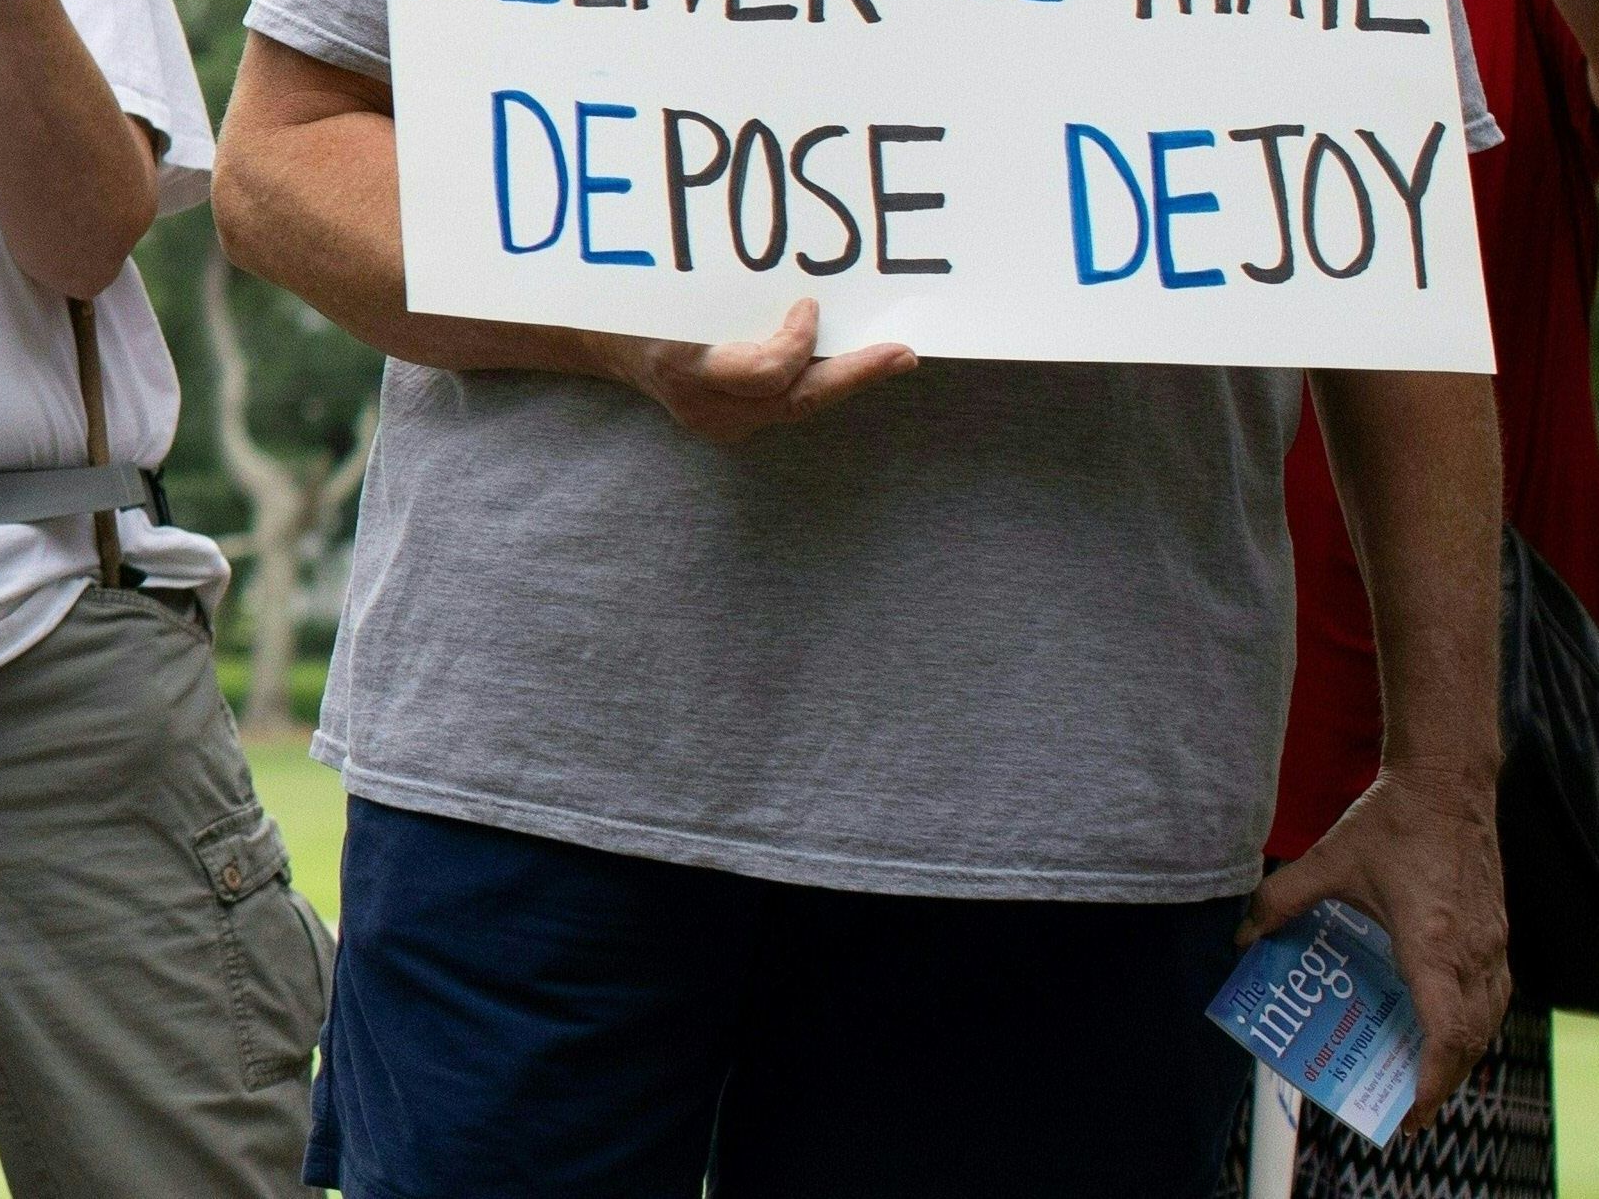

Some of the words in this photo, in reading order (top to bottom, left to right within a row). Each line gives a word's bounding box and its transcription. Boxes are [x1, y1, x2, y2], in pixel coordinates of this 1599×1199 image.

[491, 89, 952, 277] DEPOSE
[1065, 122, 1446, 291] DEJOY
[1229, 980, 1266, 1016] The
[1303, 1059, 1321, 1083] of
[1313, 1043, 1335, 1069] our
[1329, 996, 1370, 1047] country
[1348, 1023, 1378, 1060] your
[1327, 1064, 1347, 1083] is
[1336, 1052, 1357, 1070] in
